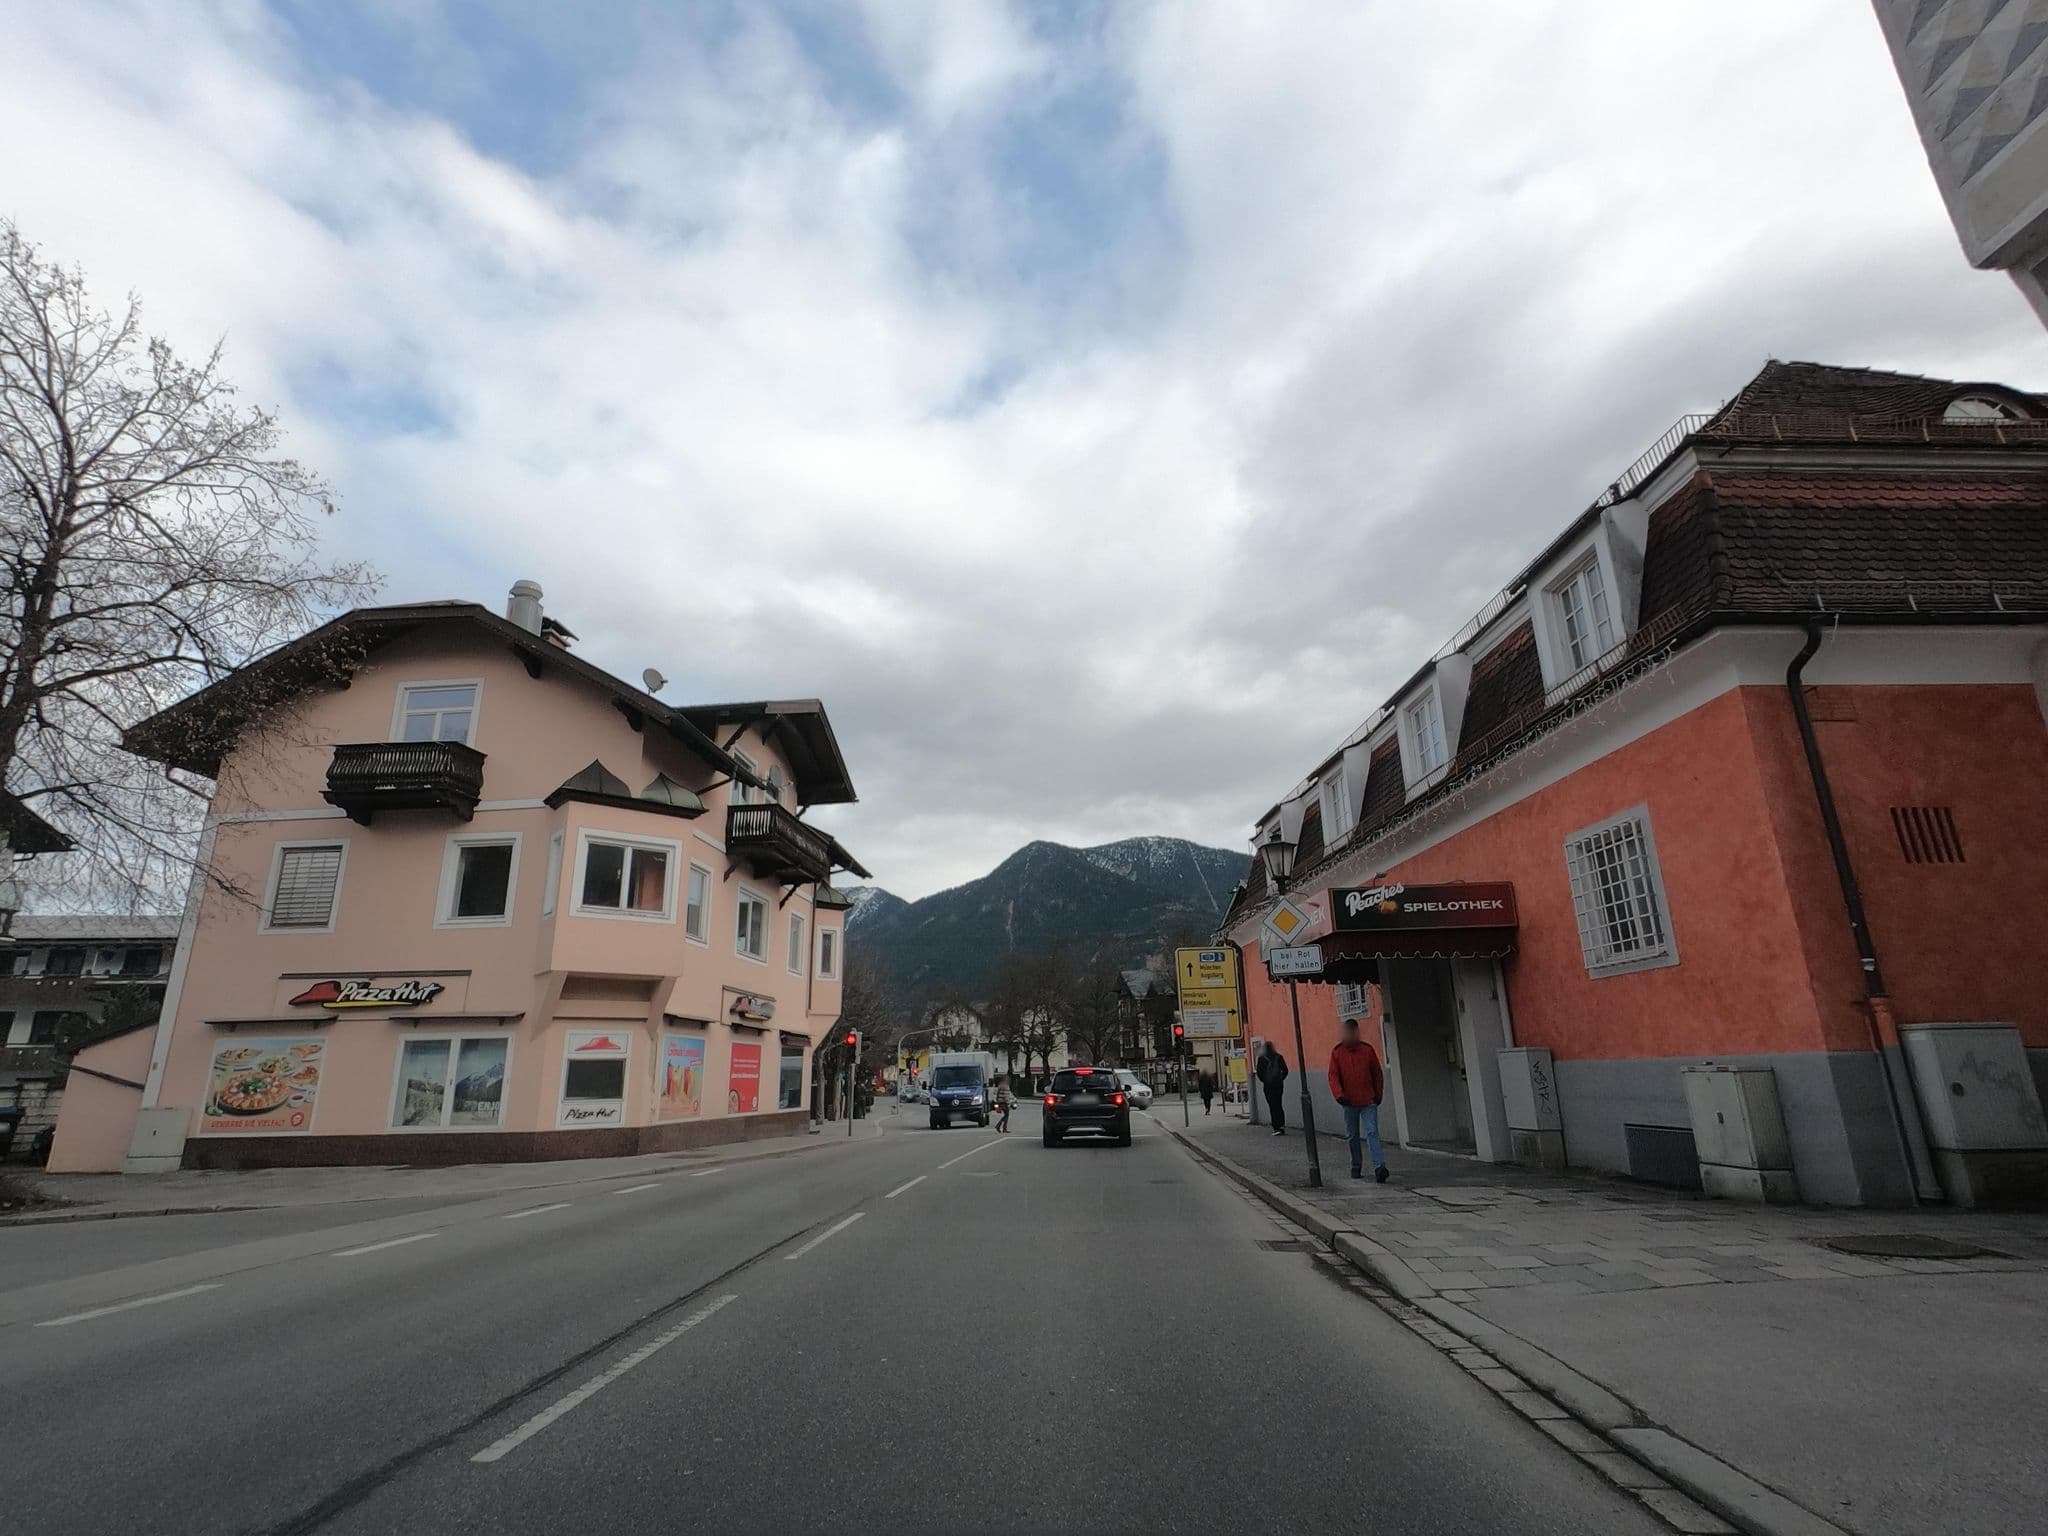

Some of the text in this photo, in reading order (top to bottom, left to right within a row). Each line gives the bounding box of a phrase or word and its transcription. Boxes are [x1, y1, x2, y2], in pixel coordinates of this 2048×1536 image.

[1345, 881, 1404, 917] Peaches
[1403, 899, 1504, 913] SPIELOTHEK
[1280, 950, 1310, 959] bei Rot
[1274, 961, 1289, 970] hier
[336, 981, 440, 1002] Pizza Hut
[565, 1107, 617, 1120] Pizza Hut
